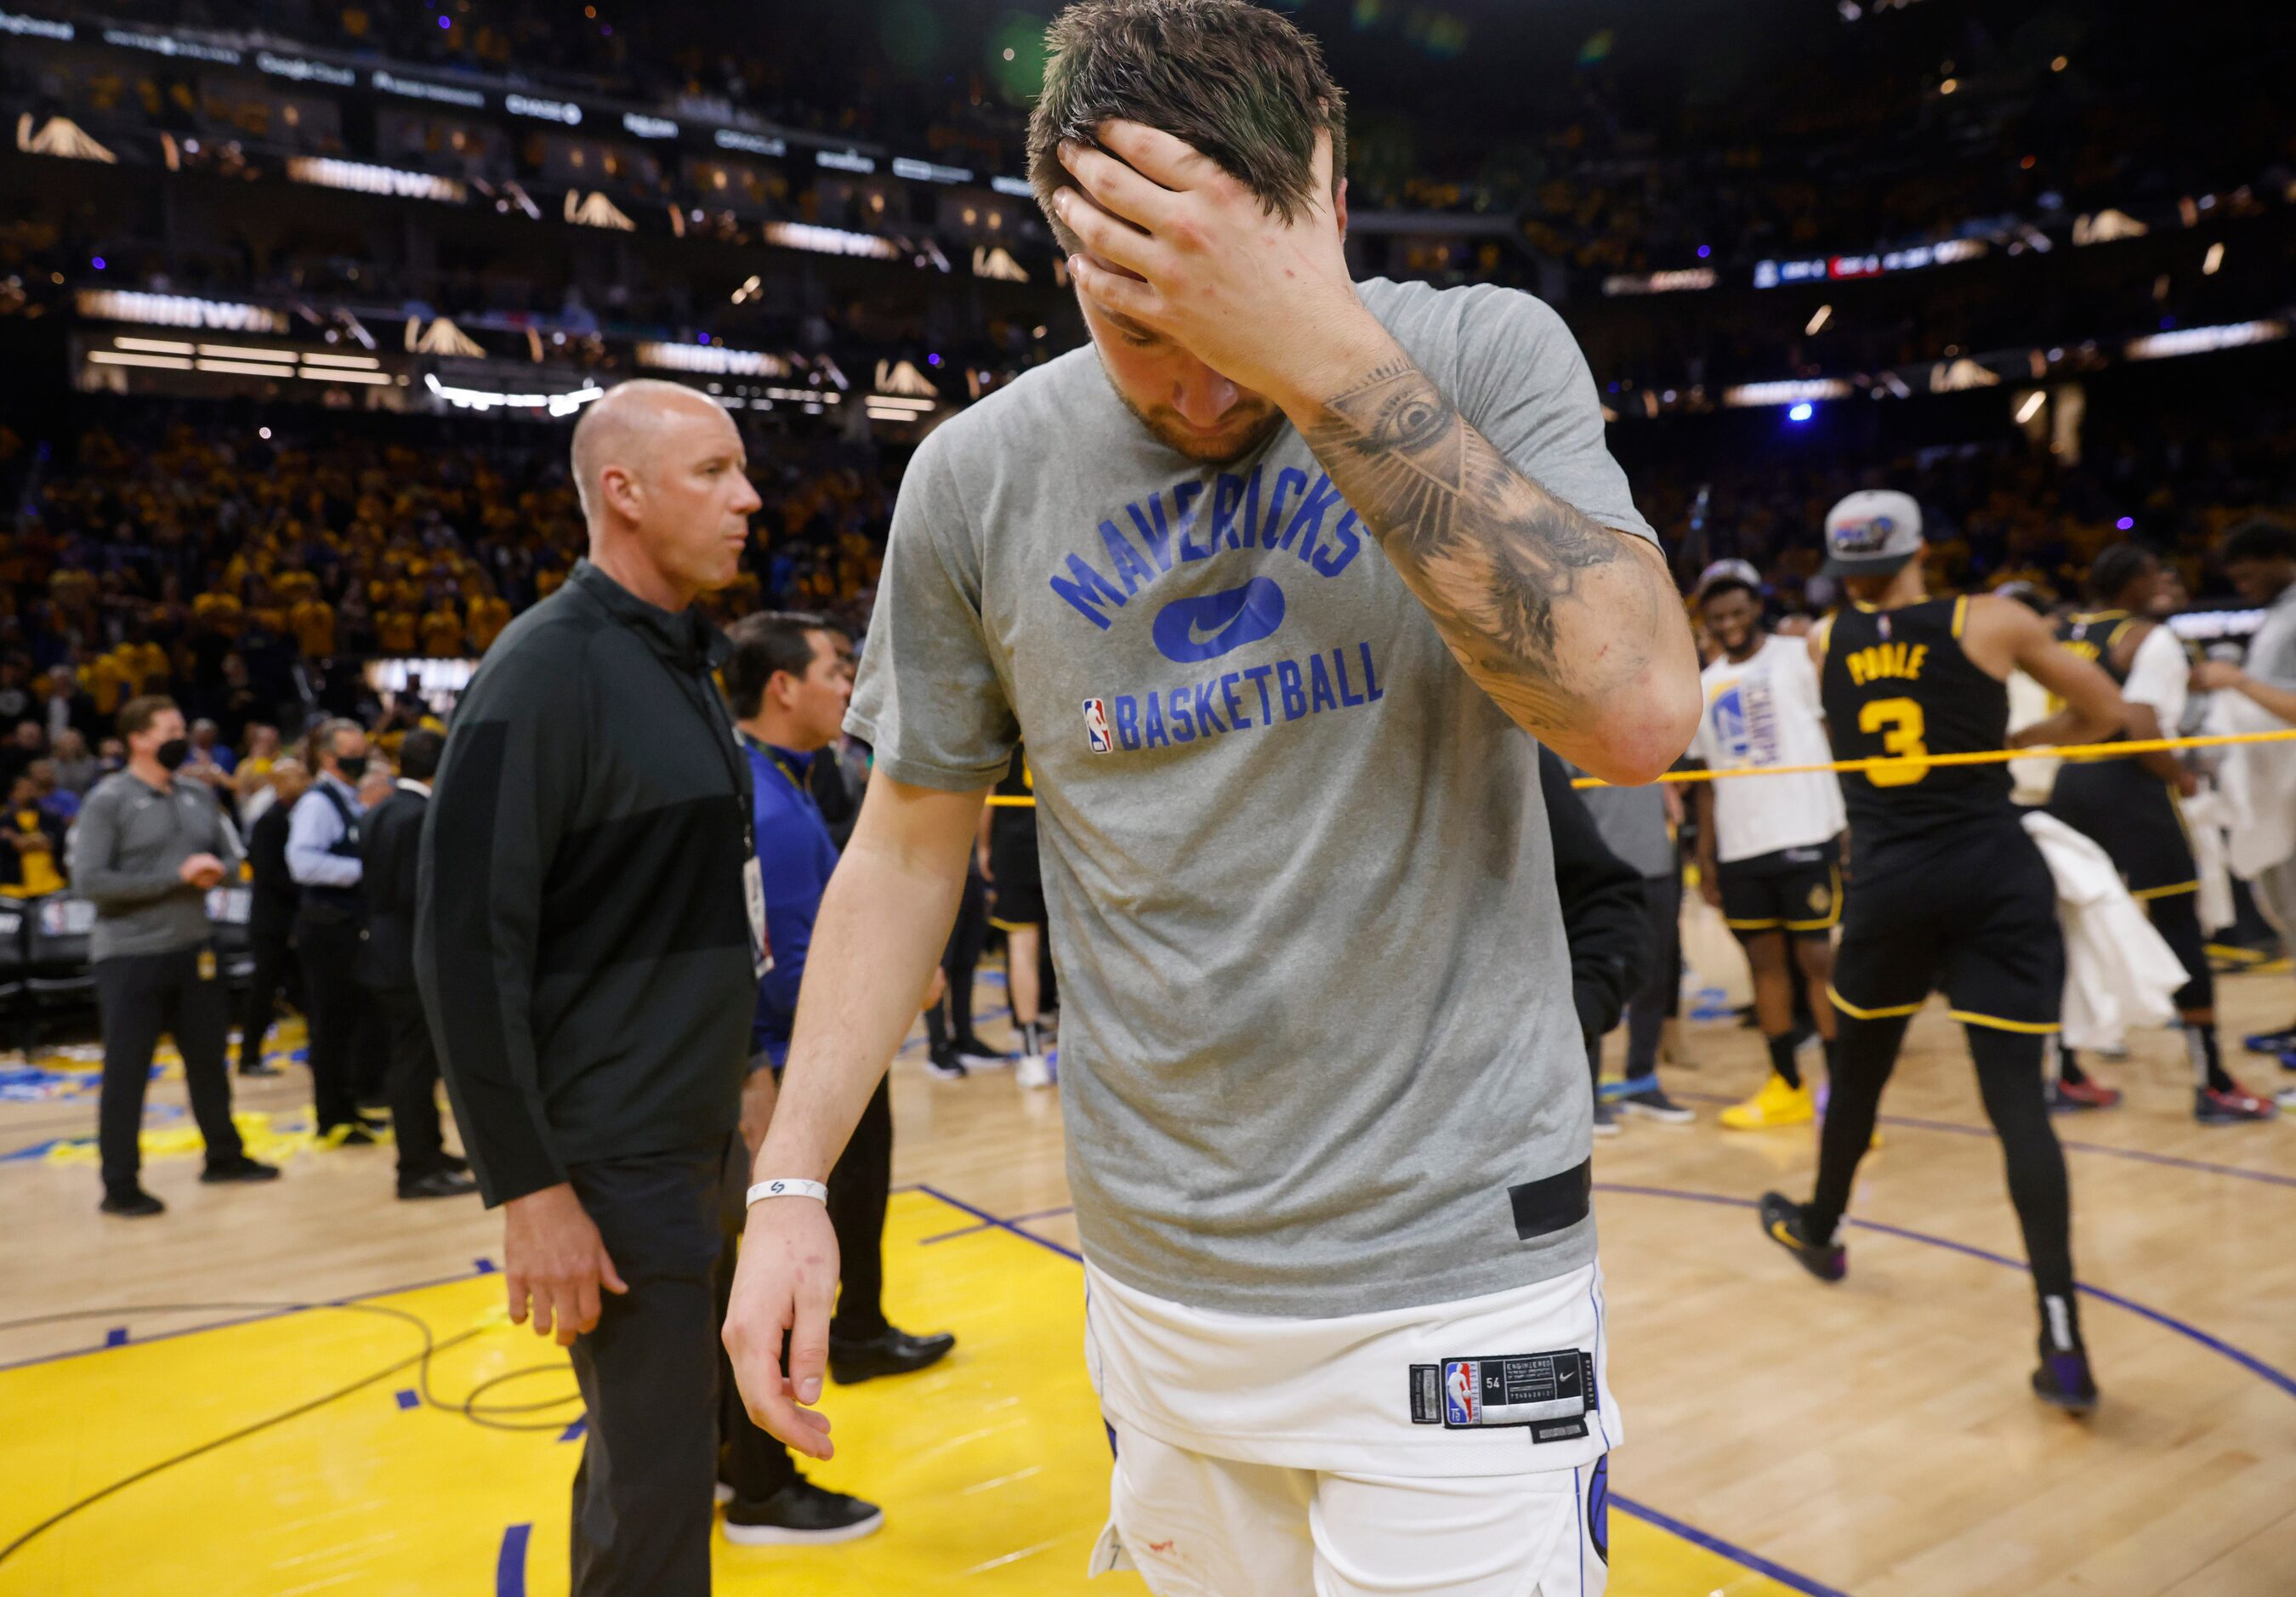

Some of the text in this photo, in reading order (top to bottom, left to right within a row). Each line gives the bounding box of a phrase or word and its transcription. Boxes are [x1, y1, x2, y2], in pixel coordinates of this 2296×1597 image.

[1049, 464, 1371, 631] MAVERICKS
[1115, 641, 1384, 752] BASKETBALL
[1845, 641, 1929, 686] POOLE
[1857, 696, 1930, 787] 3
[1450, 1407, 1461, 1422] 75
[1486, 1377, 1500, 1389] 54
